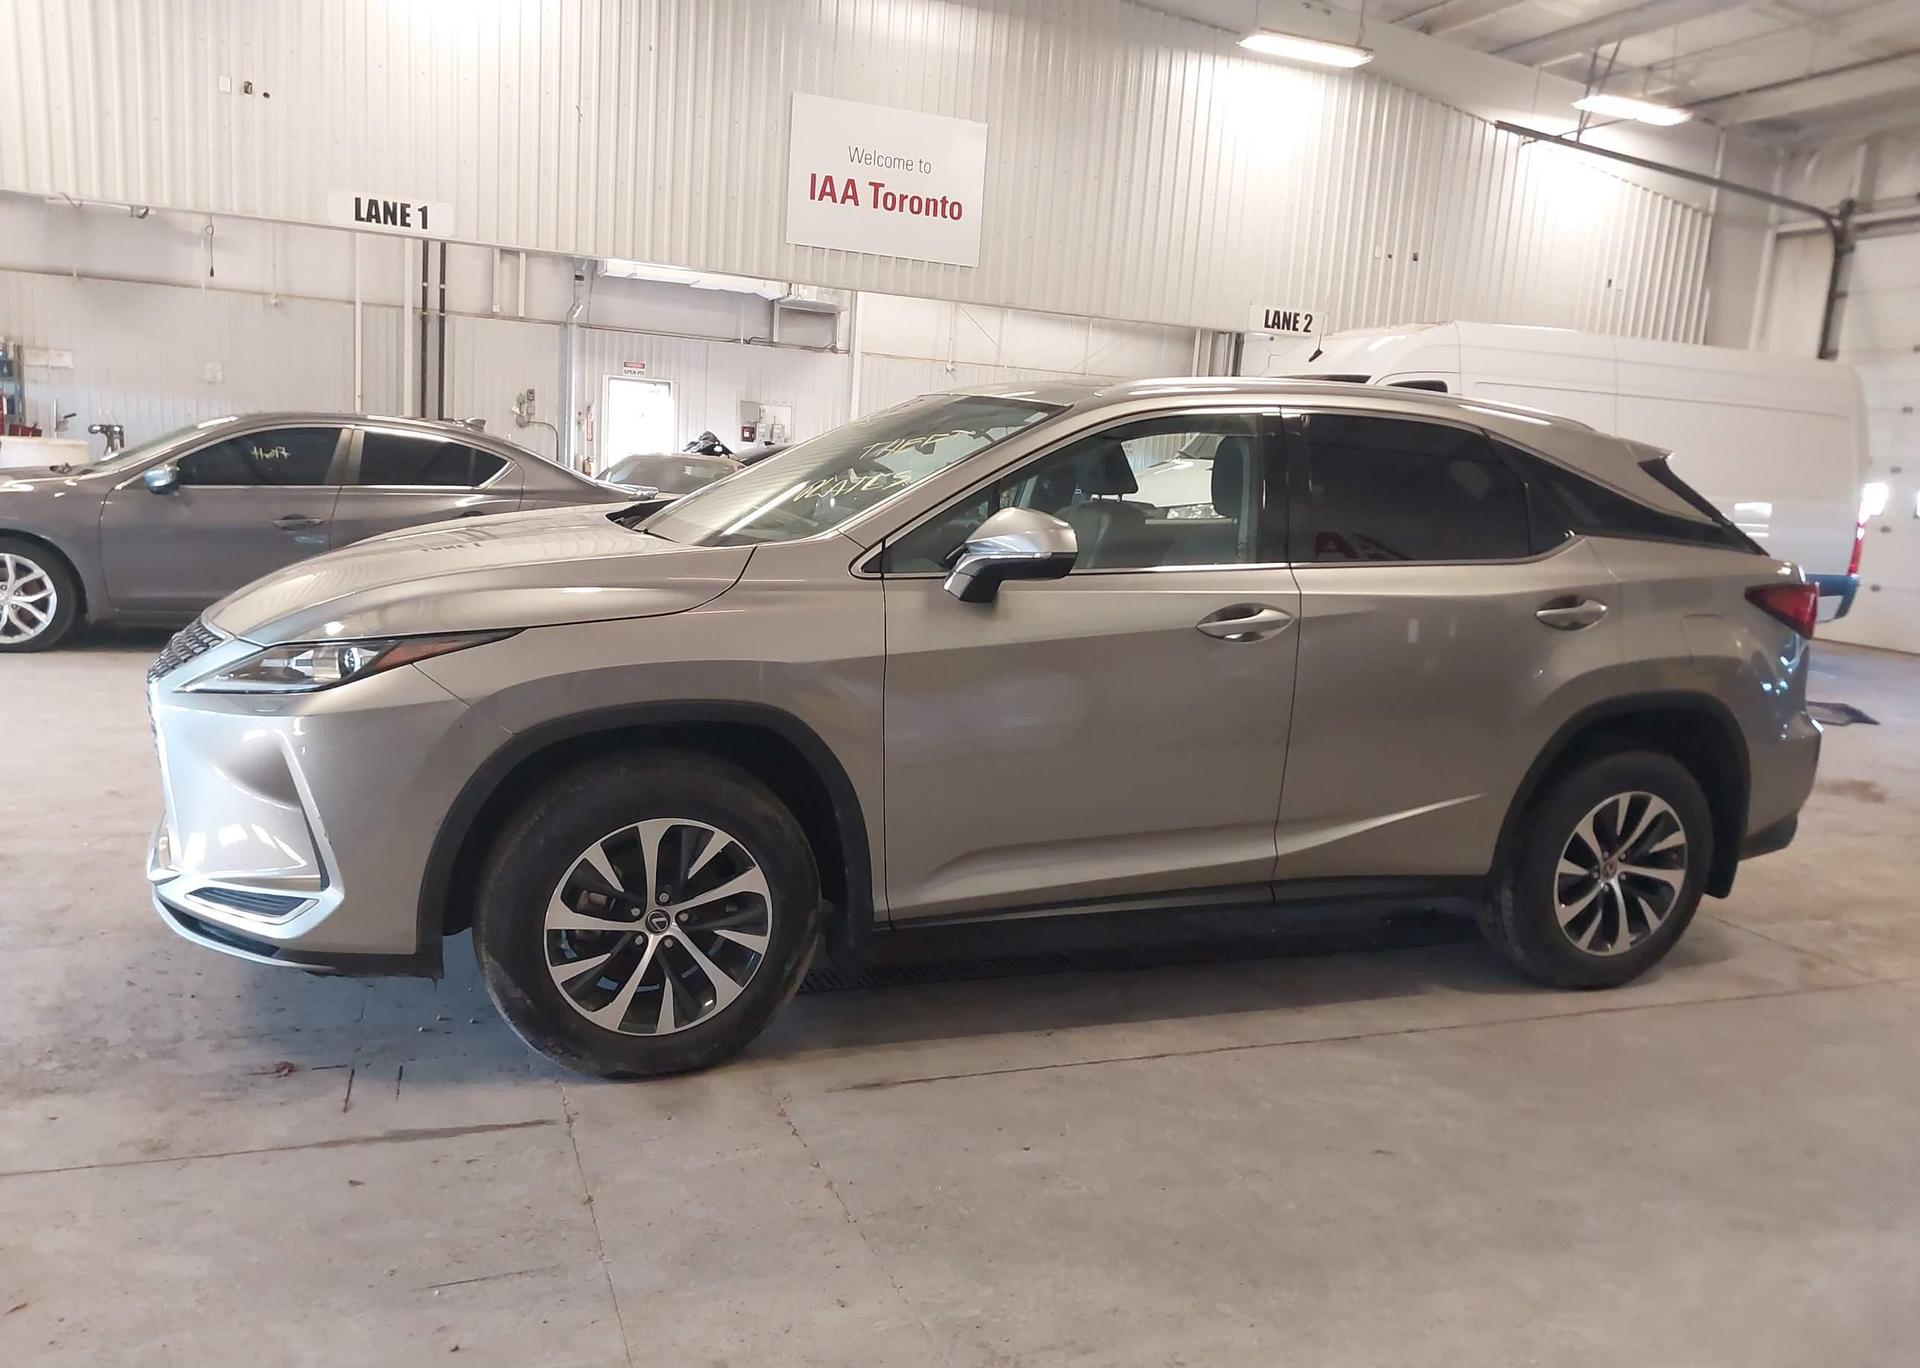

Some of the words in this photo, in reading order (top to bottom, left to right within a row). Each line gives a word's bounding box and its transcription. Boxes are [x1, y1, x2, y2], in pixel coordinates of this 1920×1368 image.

[848, 146, 914, 172] Welcome
[918, 158, 932, 175] to
[809, 173, 860, 207] IAA
[868, 181, 963, 221] Toronto
[354, 196, 411, 228] LANE
[417, 205, 428, 230] 1
[1263, 308, 1301, 332] LANE
[1302, 313, 1314, 333] 2
